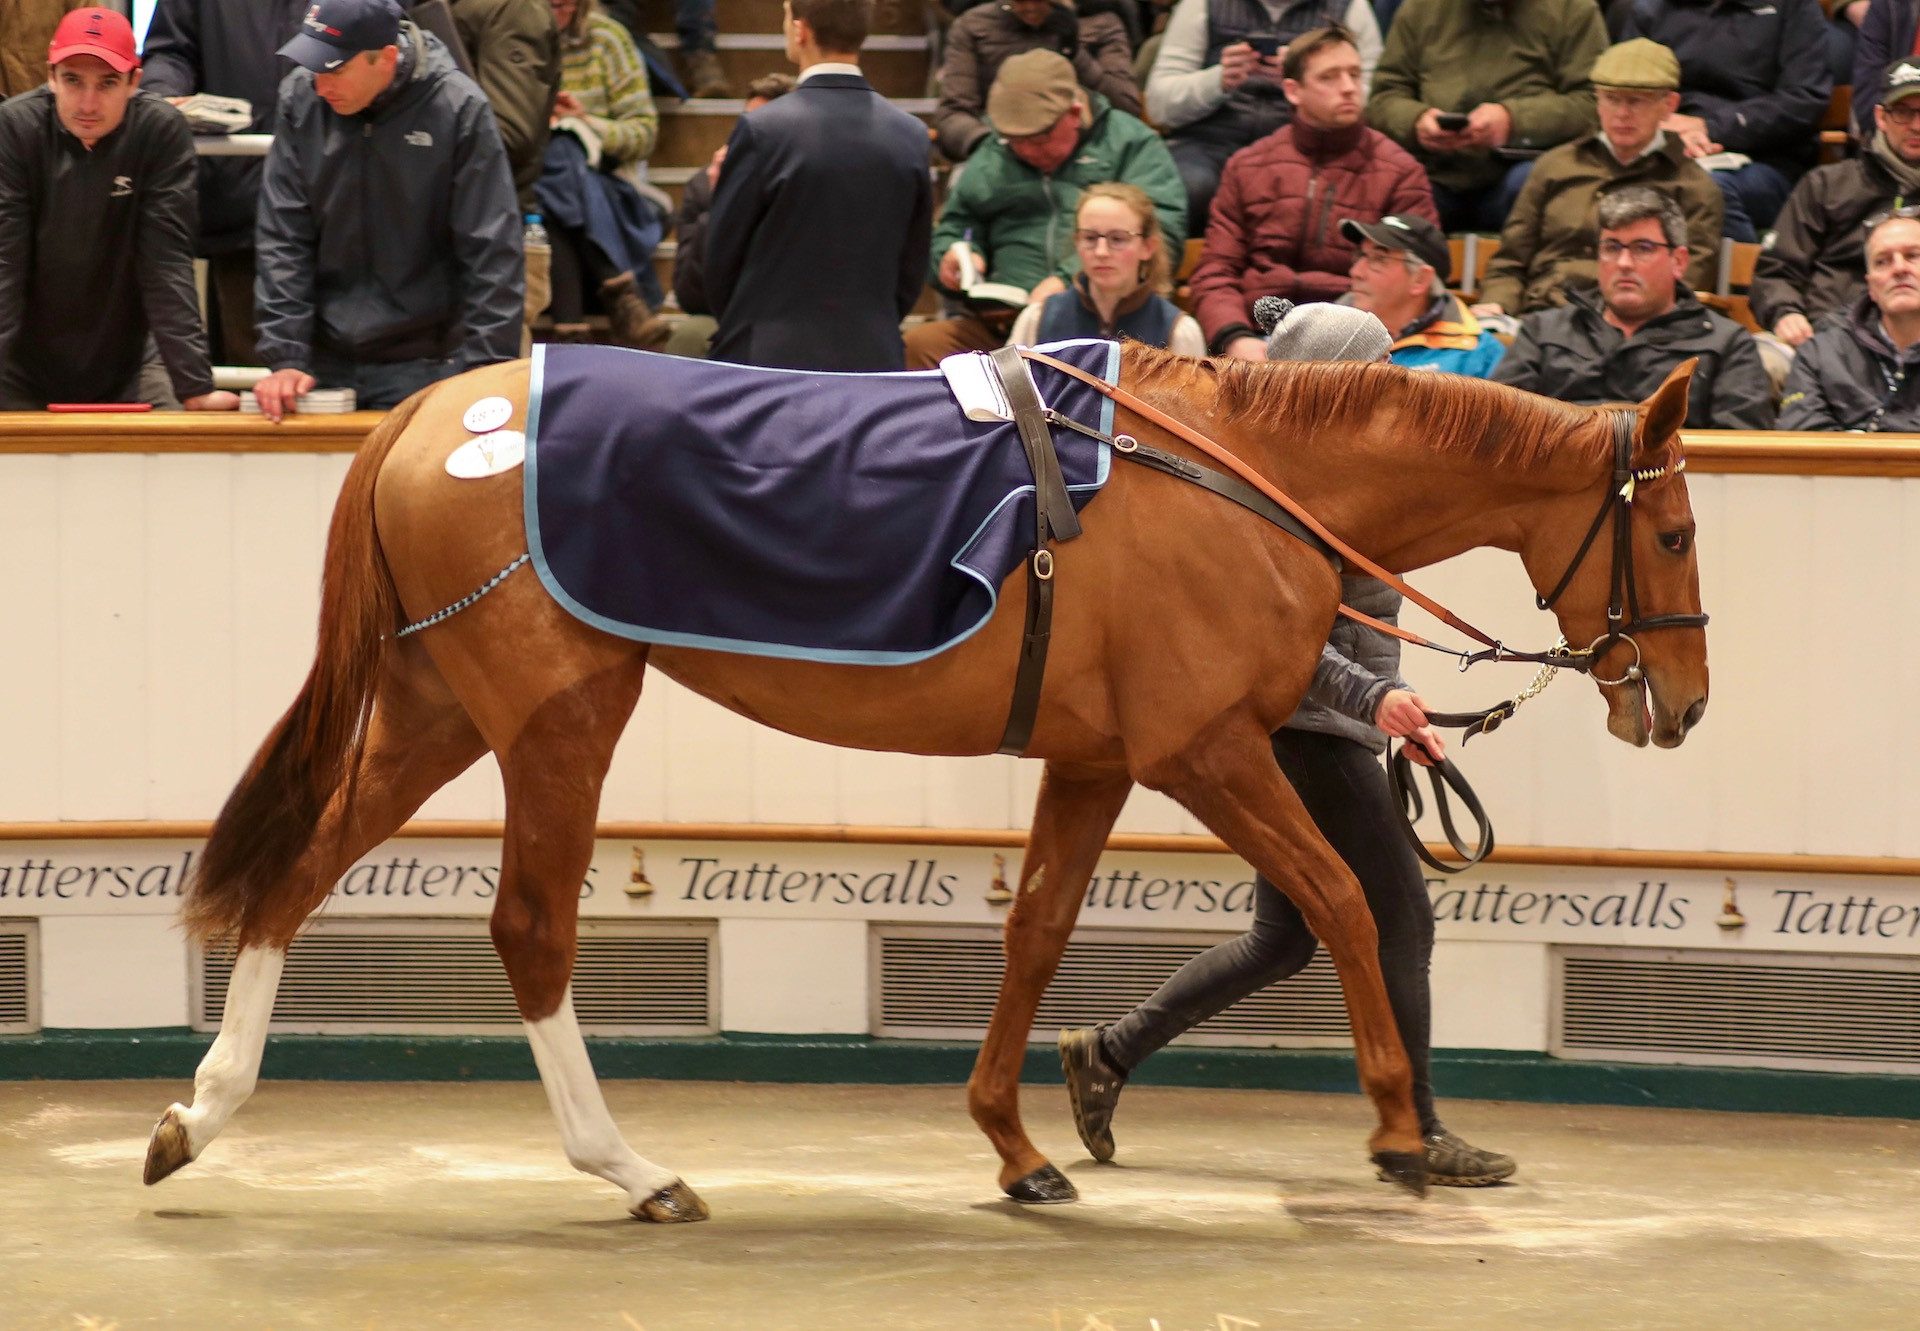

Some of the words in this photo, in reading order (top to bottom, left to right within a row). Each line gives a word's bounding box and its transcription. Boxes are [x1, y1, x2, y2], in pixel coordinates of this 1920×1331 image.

[0, 851, 192, 899] ttersal
[327, 857, 599, 899] atterss
[679, 856, 960, 907] Tattersalls
[1086, 869, 1256, 913] ttersa
